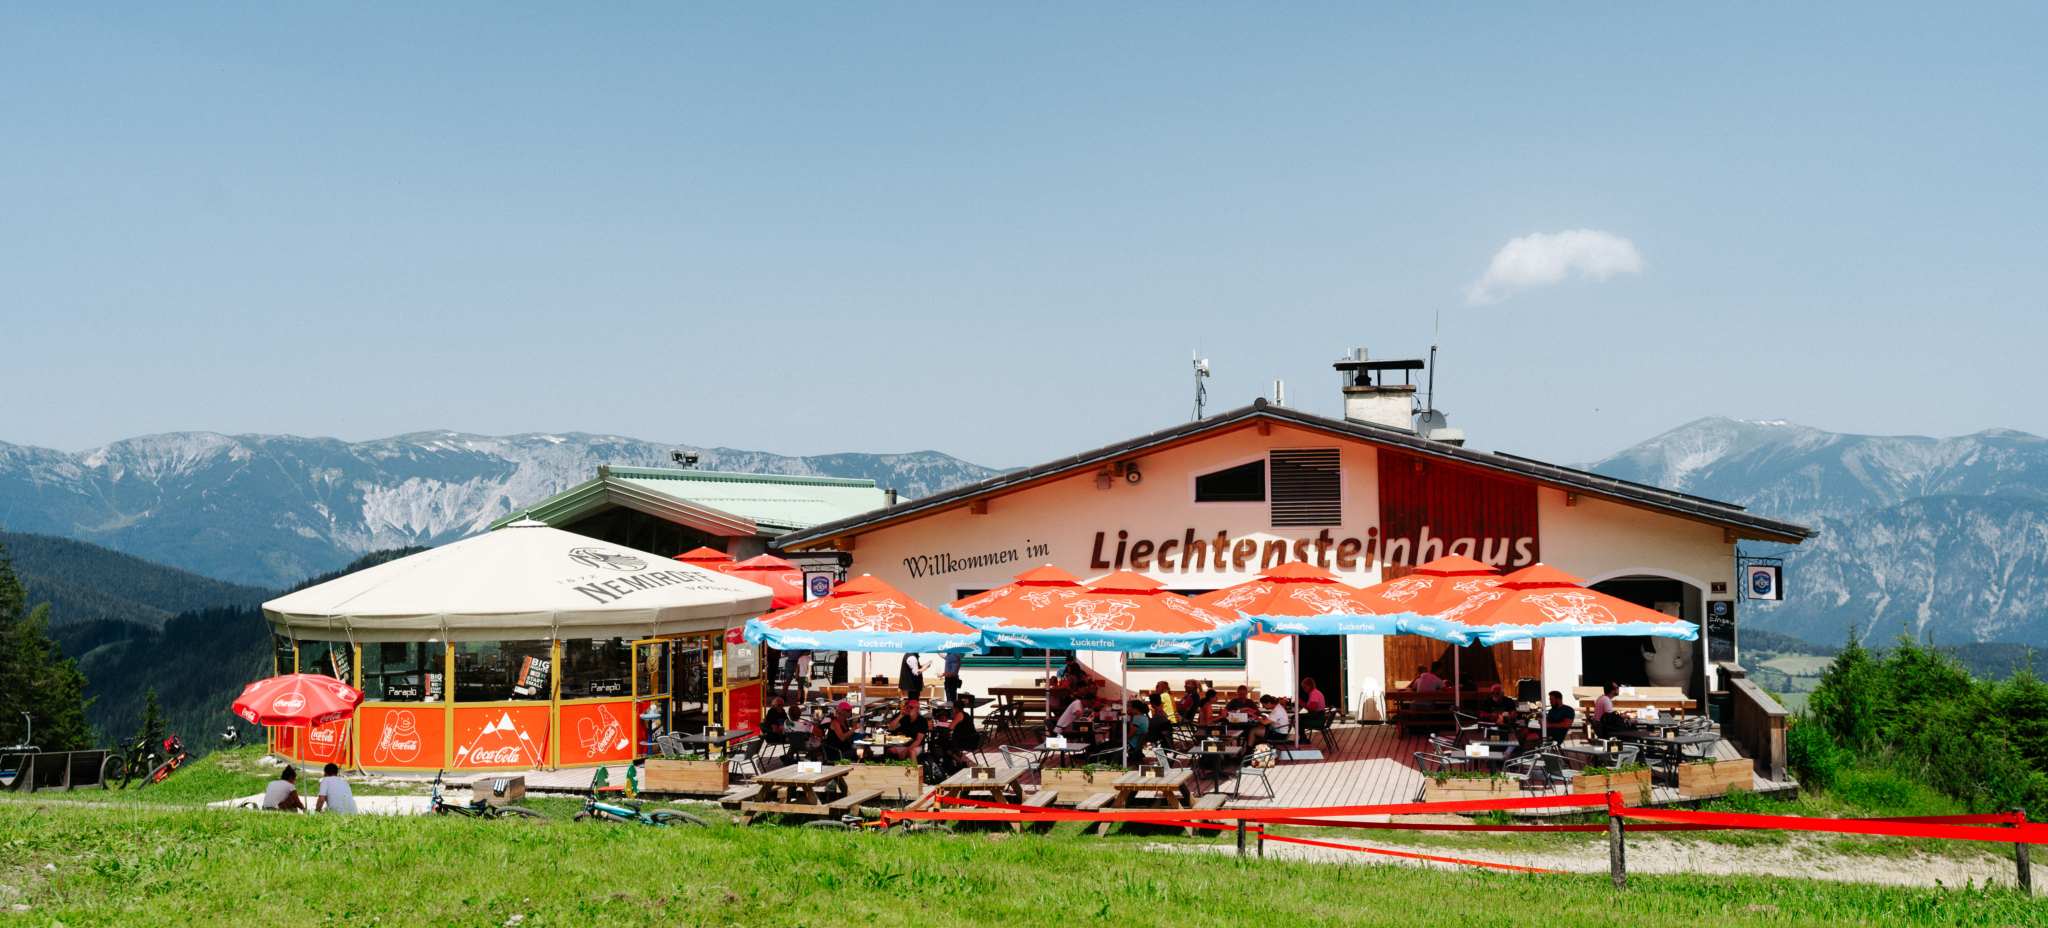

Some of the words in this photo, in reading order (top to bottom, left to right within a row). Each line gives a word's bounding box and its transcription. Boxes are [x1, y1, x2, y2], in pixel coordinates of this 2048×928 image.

[1090, 526, 1533, 569] Liechtensteinhaus
[903, 549, 1019, 579] Willkommen
[1026, 539, 1049, 558] im
[572, 570, 715, 604] NEMIROFF
[1338, 622, 1375, 631] Zuckerfrei
[776, 635, 820, 647] Almdudler
[858, 639, 903, 649] Zuckerfrei
[938, 640, 979, 651] Almdudler
[1070, 637, 1115, 647] Zuckerfrei
[1151, 638, 1195, 651] Almdudler
[531, 657, 550, 669] BIG
[527, 676, 544, 684] START
[392, 740, 418, 750] Coca-Cola
[470, 746, 522, 764] Coca-Cola
